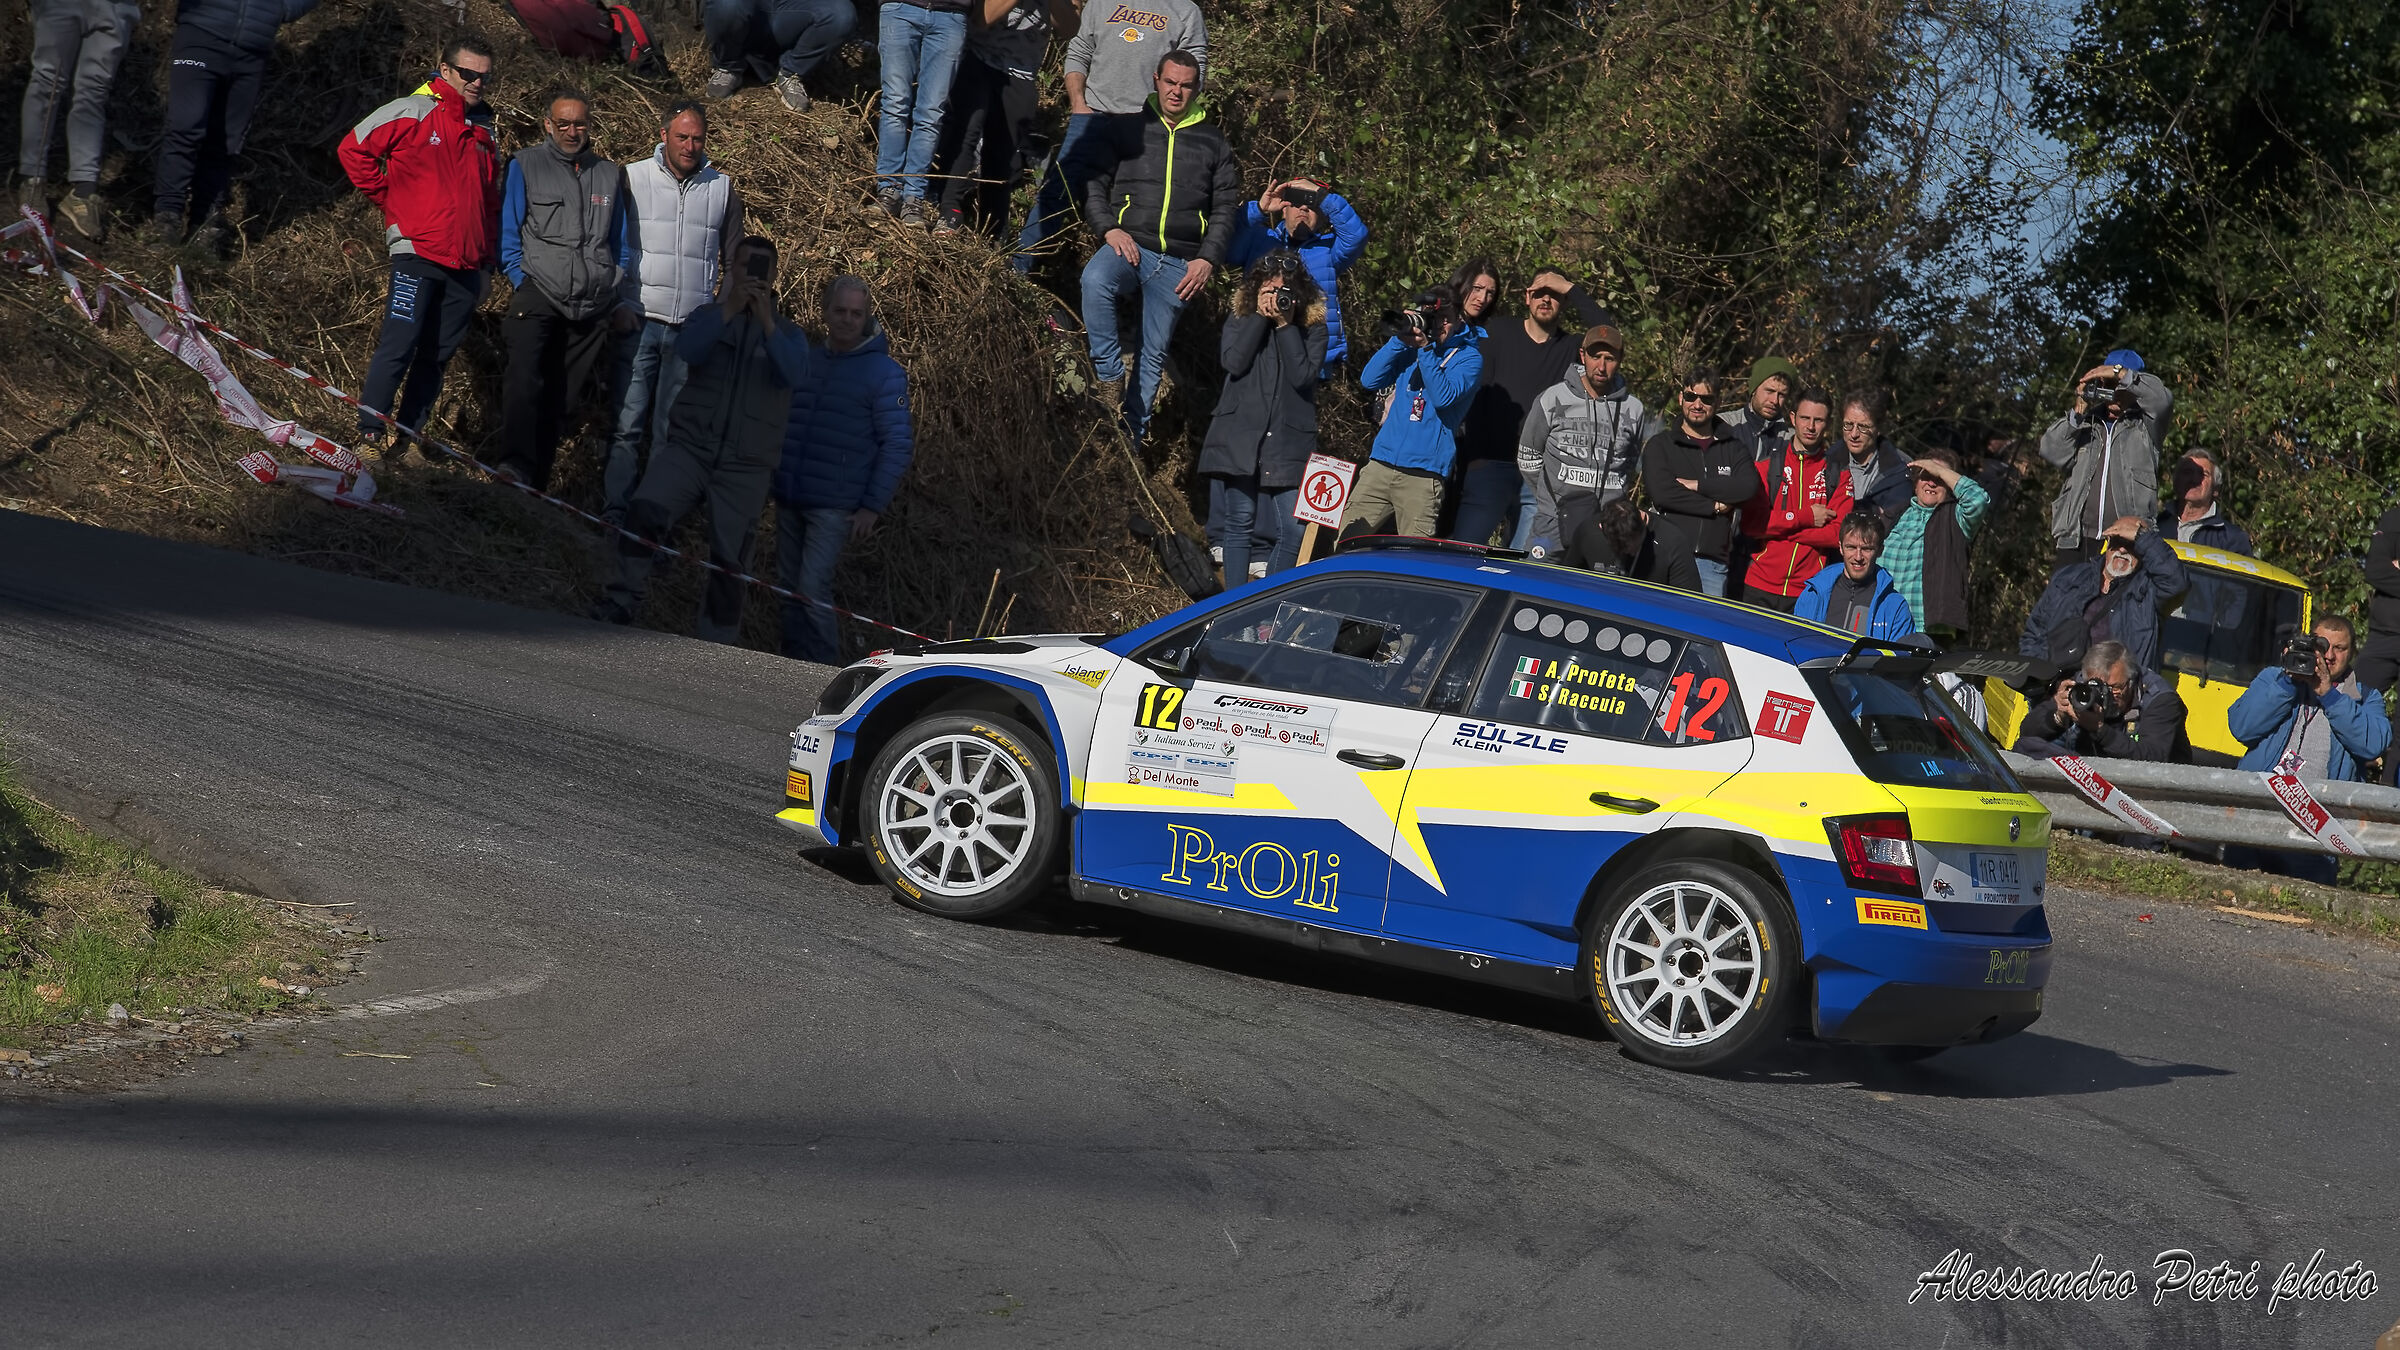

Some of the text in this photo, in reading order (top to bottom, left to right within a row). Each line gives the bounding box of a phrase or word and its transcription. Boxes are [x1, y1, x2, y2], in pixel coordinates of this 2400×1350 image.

[1104, 4, 1169, 32] LAKERS
[1320, 517, 1334, 525] AREA
[2175, 546, 2260, 573] 144
[1063, 664, 1106, 680] Island
[1544, 660, 1637, 693] A. Profeta
[1140, 684, 1185, 731] 12
[1537, 684, 1626, 716] S. Raccuia
[1663, 672, 1730, 741] 12
[1155, 734, 1216, 750] Italiana Servizi
[1452, 738, 1502, 753] KLEIN
[1456, 722, 1568, 754] SÜLZLE
[1143, 769, 1199, 787] Del Monte
[2056, 756, 2105, 798] PERICOLOSA
[2272, 777, 2320, 830] PERICOLOSA
[2289, 782, 2311, 807] ZONA
[1161, 823, 1340, 913] PrOli
[1980, 860, 2019, 883] 11R 0412
[1864, 903, 1921, 924] PIRELLI
[1984, 950, 2030, 984] PrOli
